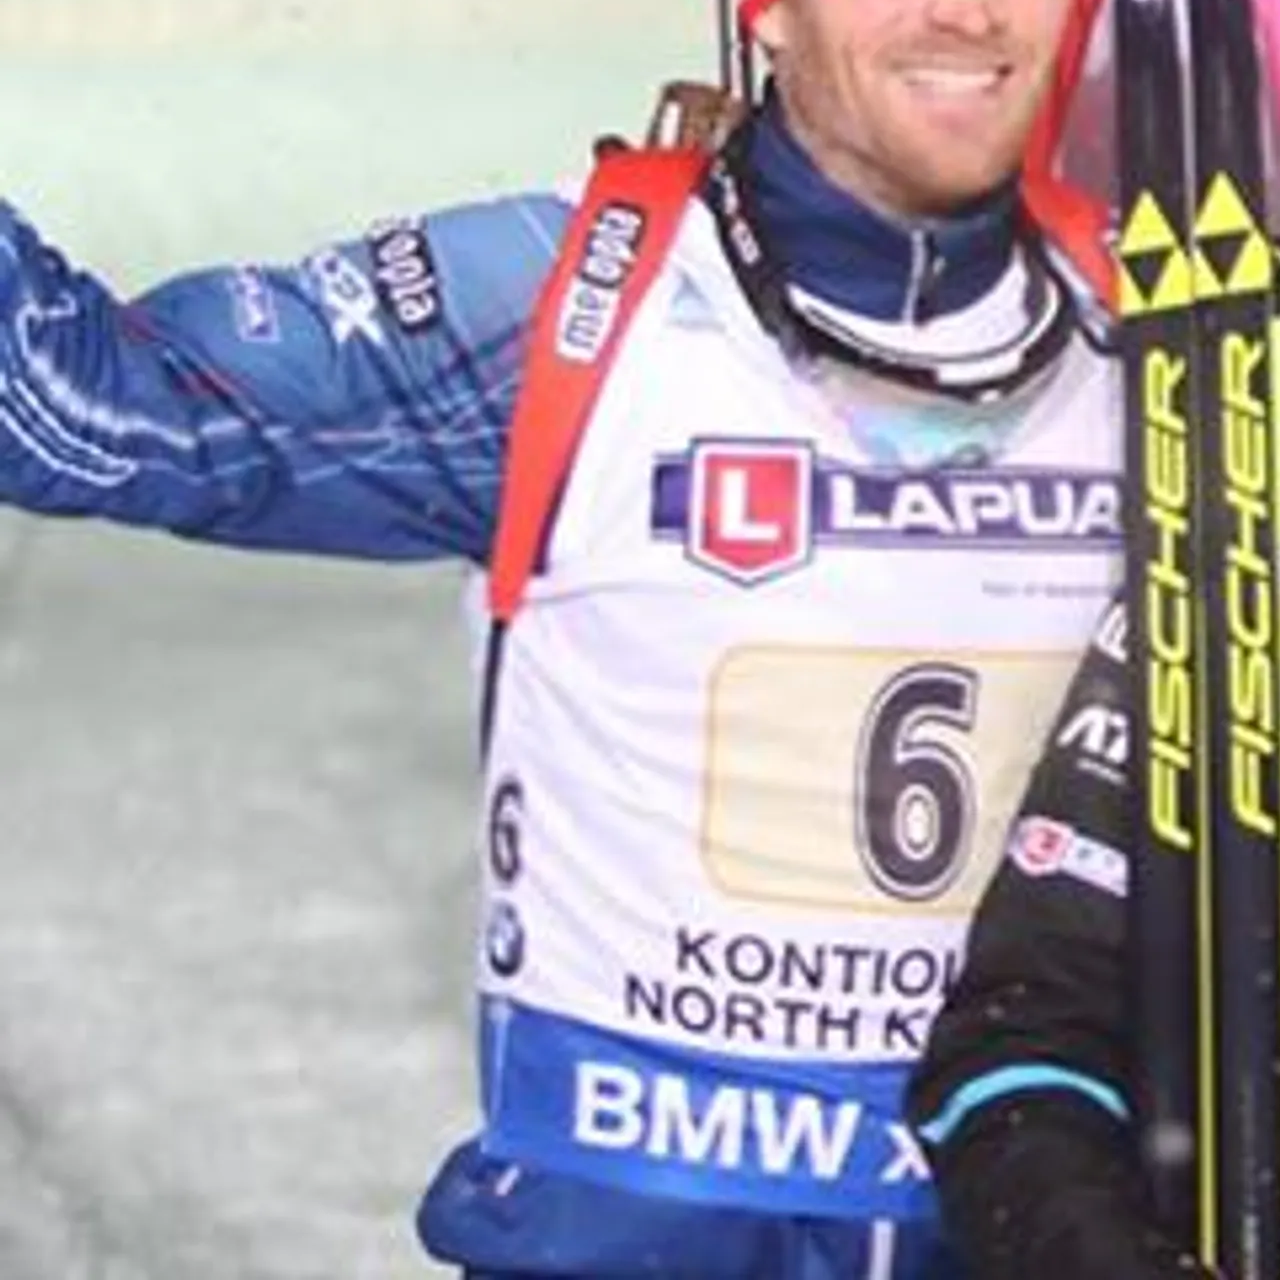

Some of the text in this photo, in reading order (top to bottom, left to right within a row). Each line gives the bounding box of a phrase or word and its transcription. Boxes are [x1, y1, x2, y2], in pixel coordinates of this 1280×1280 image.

[829, 475, 1122, 537] LAPUA
[1222, 331, 1276, 836] FISCHER
[1144, 348, 1194, 850] FISCHER
[855, 662, 980, 903] 6
[626, 975, 862, 1050] NORTH
[572, 1058, 863, 1183] BMW
